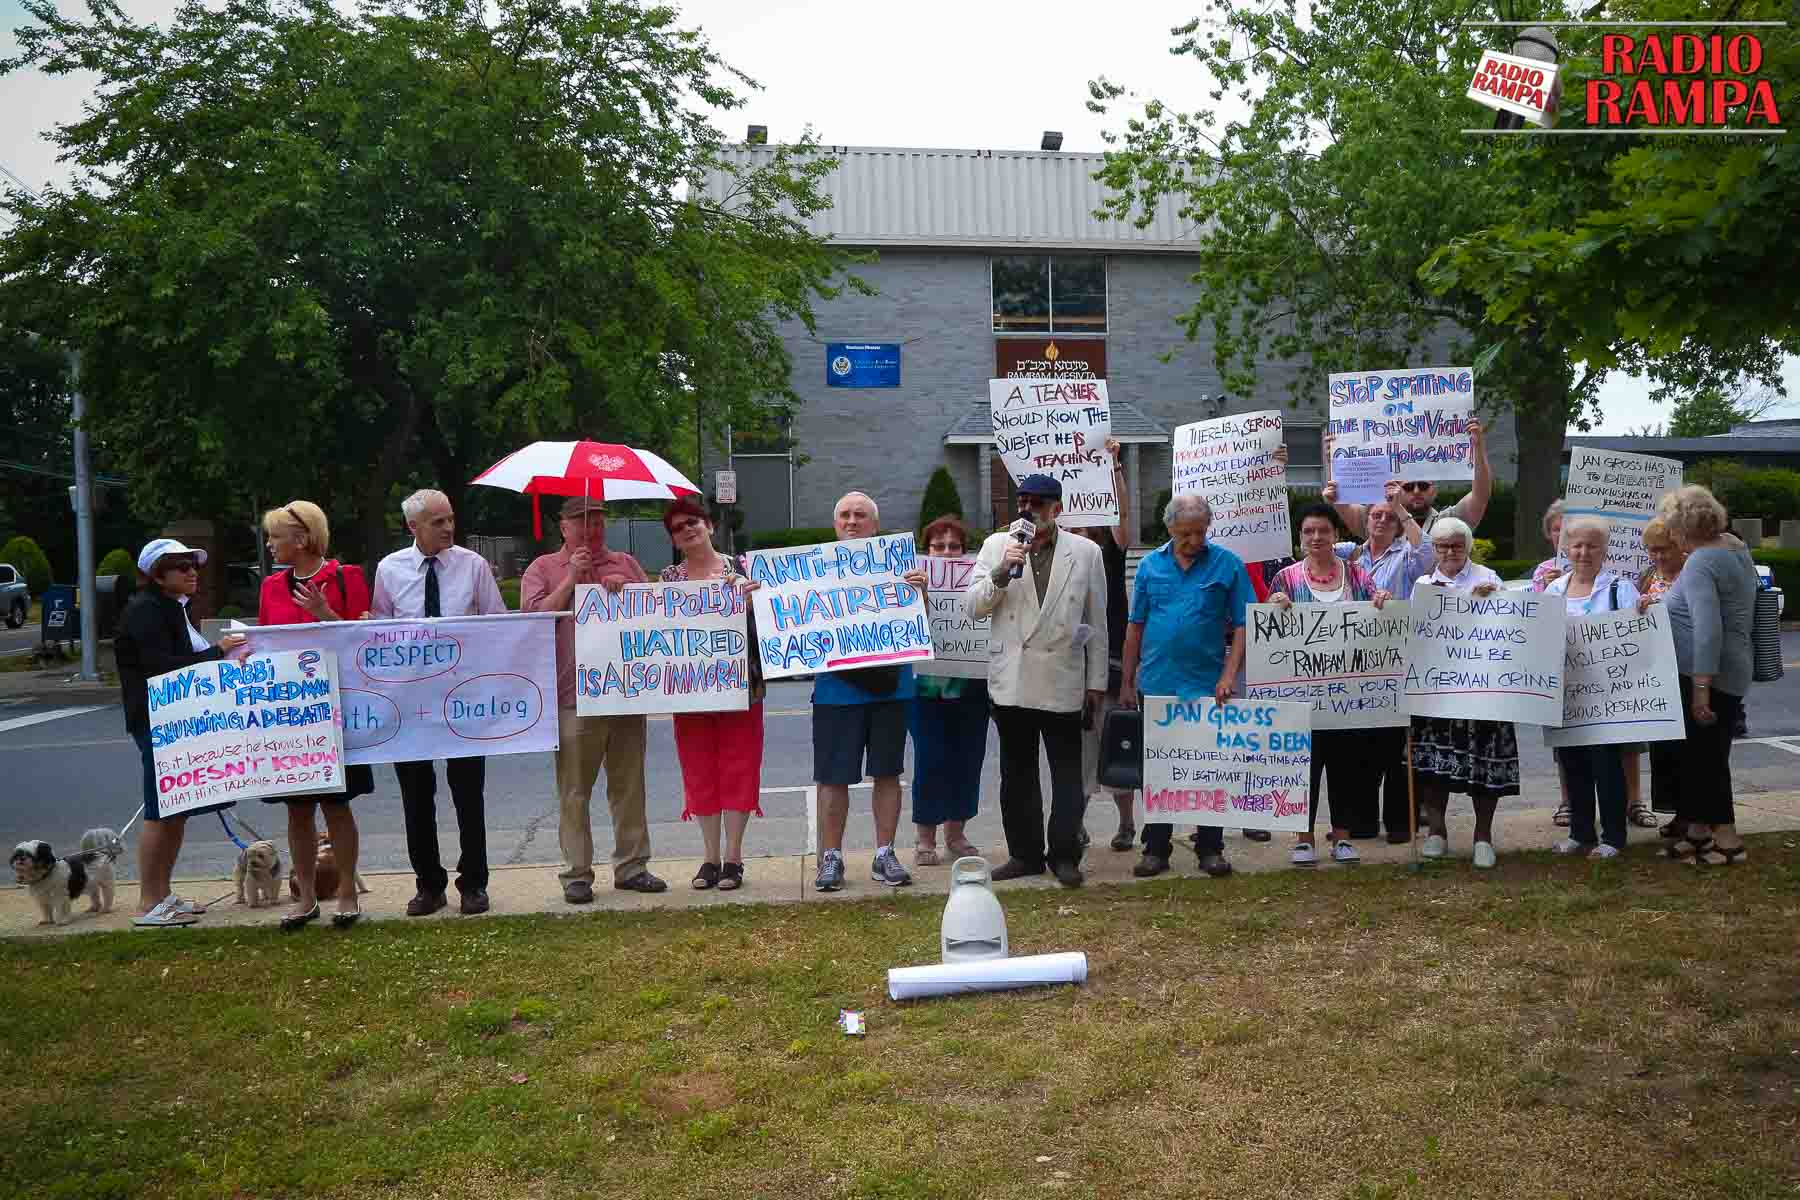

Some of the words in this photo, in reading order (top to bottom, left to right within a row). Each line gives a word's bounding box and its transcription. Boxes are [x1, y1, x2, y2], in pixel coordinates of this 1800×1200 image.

[1004, 386, 1025, 408] A
[1030, 383, 1100, 404] TEACHER
[992, 410, 1043, 431] SHOULD
[1046, 408, 1080, 429] KNOW
[1082, 407, 1108, 426] THE
[1383, 400, 1414, 416] ON
[1190, 426, 1223, 446] THERE
[1222, 421, 1232, 433] IS
[1329, 418, 1359, 434] THE
[1061, 469, 1083, 481] AT
[1173, 460, 1230, 481] HOLOCAUST
[1576, 455, 1600, 470] JAN
[1644, 461, 1665, 473] HAS
[1667, 463, 1681, 475] YET
[1175, 480, 1185, 493] IF
[1188, 479, 1198, 489] IT
[1200, 472, 1245, 488] TEACHES
[1247, 466, 1284, 483] HATRED
[1586, 471, 1601, 481] TO
[1604, 473, 1664, 488] DEBATE
[1235, 488, 1265, 507] THOSE
[1266, 485, 1287, 501] WHO
[1266, 502, 1285, 513] THE
[1645, 502, 1656, 511] IN
[770, 582, 919, 631] HATRED
[1428, 594, 1539, 621] JEDWABNE
[374, 628, 443, 643] MUTUAL
[1253, 609, 1304, 643] RABBI
[1436, 623, 1464, 640] AND
[1468, 626, 1527, 643] ALWAYS
[1580, 622, 1614, 643] HAVE
[1615, 613, 1658, 638] BEEN
[620, 627, 745, 662] HATRED
[783, 630, 834, 668] ALSO
[836, 616, 930, 656] IMMORAL
[1447, 646, 1482, 660] WILL
[1488, 648, 1513, 661] BE
[364, 643, 457, 668] RESPECT
[1291, 649, 1347, 678] RAMBAM
[602, 661, 661, 698] ALSO
[1404, 663, 1420, 689] A
[1425, 667, 1489, 688] GERMAN
[1607, 663, 1628, 678] BY
[150, 670, 195, 711] WHY
[1328, 683, 1349, 697] FOR
[1359, 679, 1398, 694] YOUR
[1611, 681, 1633, 695] AND
[245, 710, 260, 729] A
[261, 701, 332, 729] DEBATE
[452, 695, 528, 720] Dialog
[1152, 704, 1201, 726] JAN
[1207, 704, 1277, 729] GROSS
[1605, 697, 1669, 718] RESEARCH
[172, 757, 183, 770] it
[246, 737, 262, 752] he
[263, 737, 303, 752] knows
[305, 735, 327, 748] he
[1217, 730, 1260, 751] HAS
[1269, 732, 1312, 751] BEEN
[159, 755, 265, 793] DOESN'T
[271, 744, 337, 772] KNOW
[1146, 747, 1229, 761] DISCREDITED
[1232, 754, 1242, 763] A
[1243, 754, 1267, 765] LONG
[1269, 755, 1290, 764] TIME
[1292, 756, 1312, 766] AGO
[1172, 767, 1190, 781] BY
[159, 791, 192, 810] WHAT
[1145, 785, 1226, 812] WHERE
[1231, 794, 1273, 812] WERE
